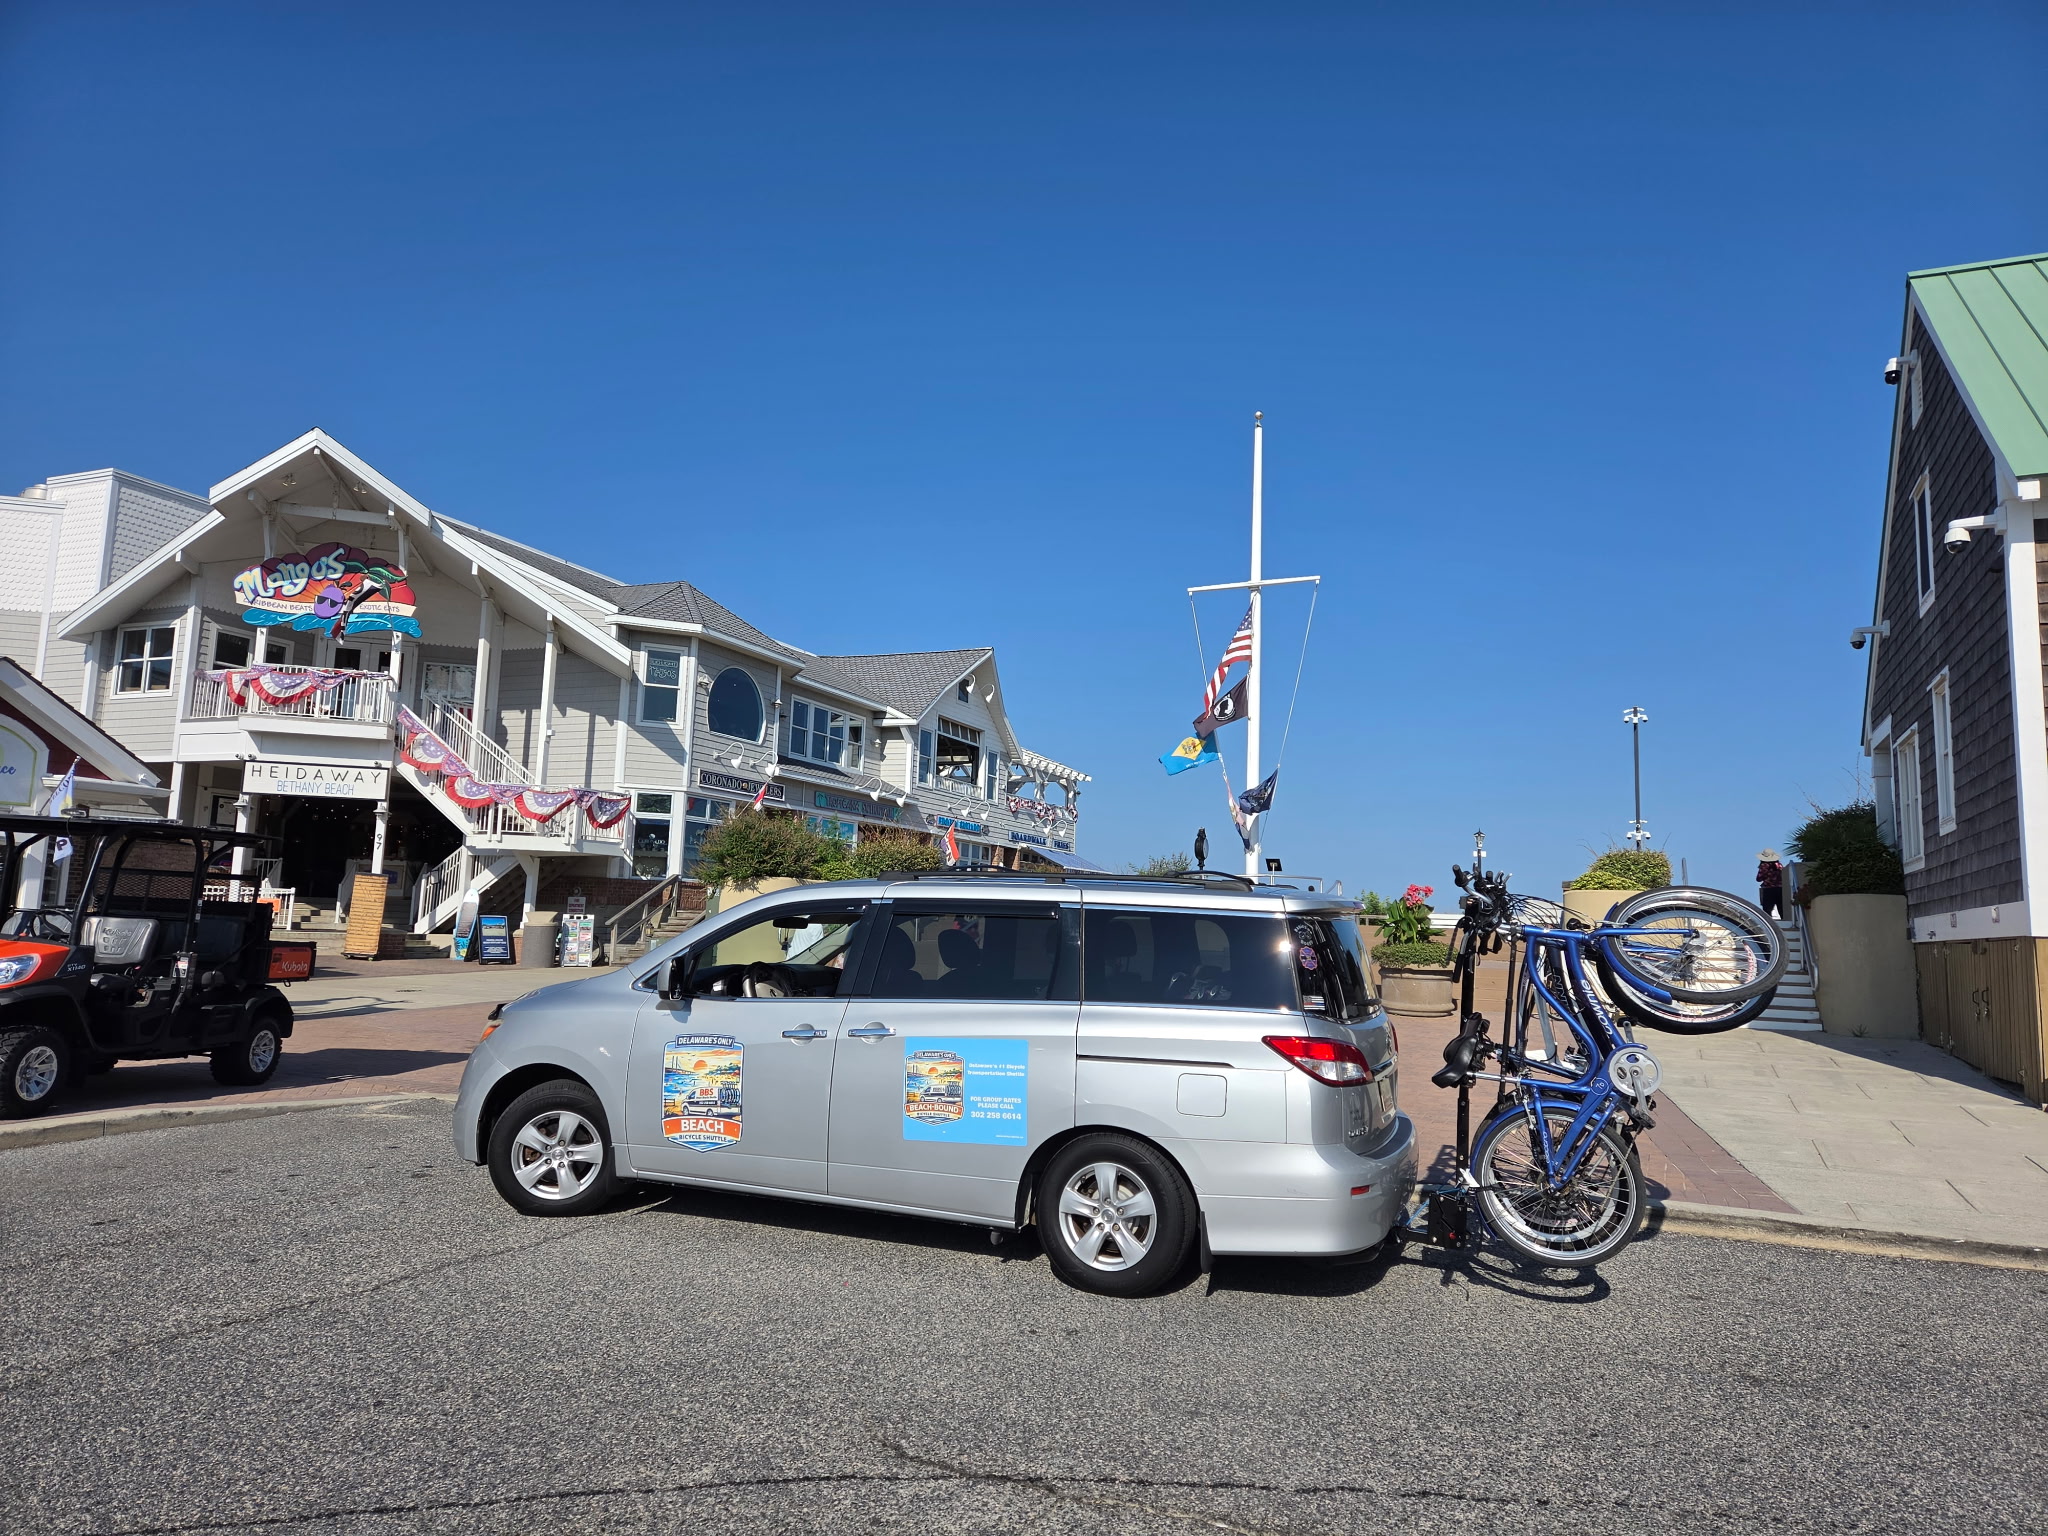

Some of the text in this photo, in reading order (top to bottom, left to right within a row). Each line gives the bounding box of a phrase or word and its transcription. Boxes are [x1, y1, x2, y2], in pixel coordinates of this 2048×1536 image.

[289, 604, 313, 612] BEATS
[383, 604, 401, 613] EATS
[251, 765, 381, 784] HEIDAWAY
[277, 780, 355, 796] BETHANY BEACH
[701, 773, 783, 797] CORONADO JEWLERS
[1011, 831, 1069, 850] BOARDWALK FRIES
[281, 960, 308, 972] Kubota
[678, 1036, 733, 1046] DELAWARE'S ONLY
[699, 1088, 714, 1096] BBS
[909, 1103, 959, 1113] BEACH-BOUND
[681, 1119, 724, 1133] BEACH
